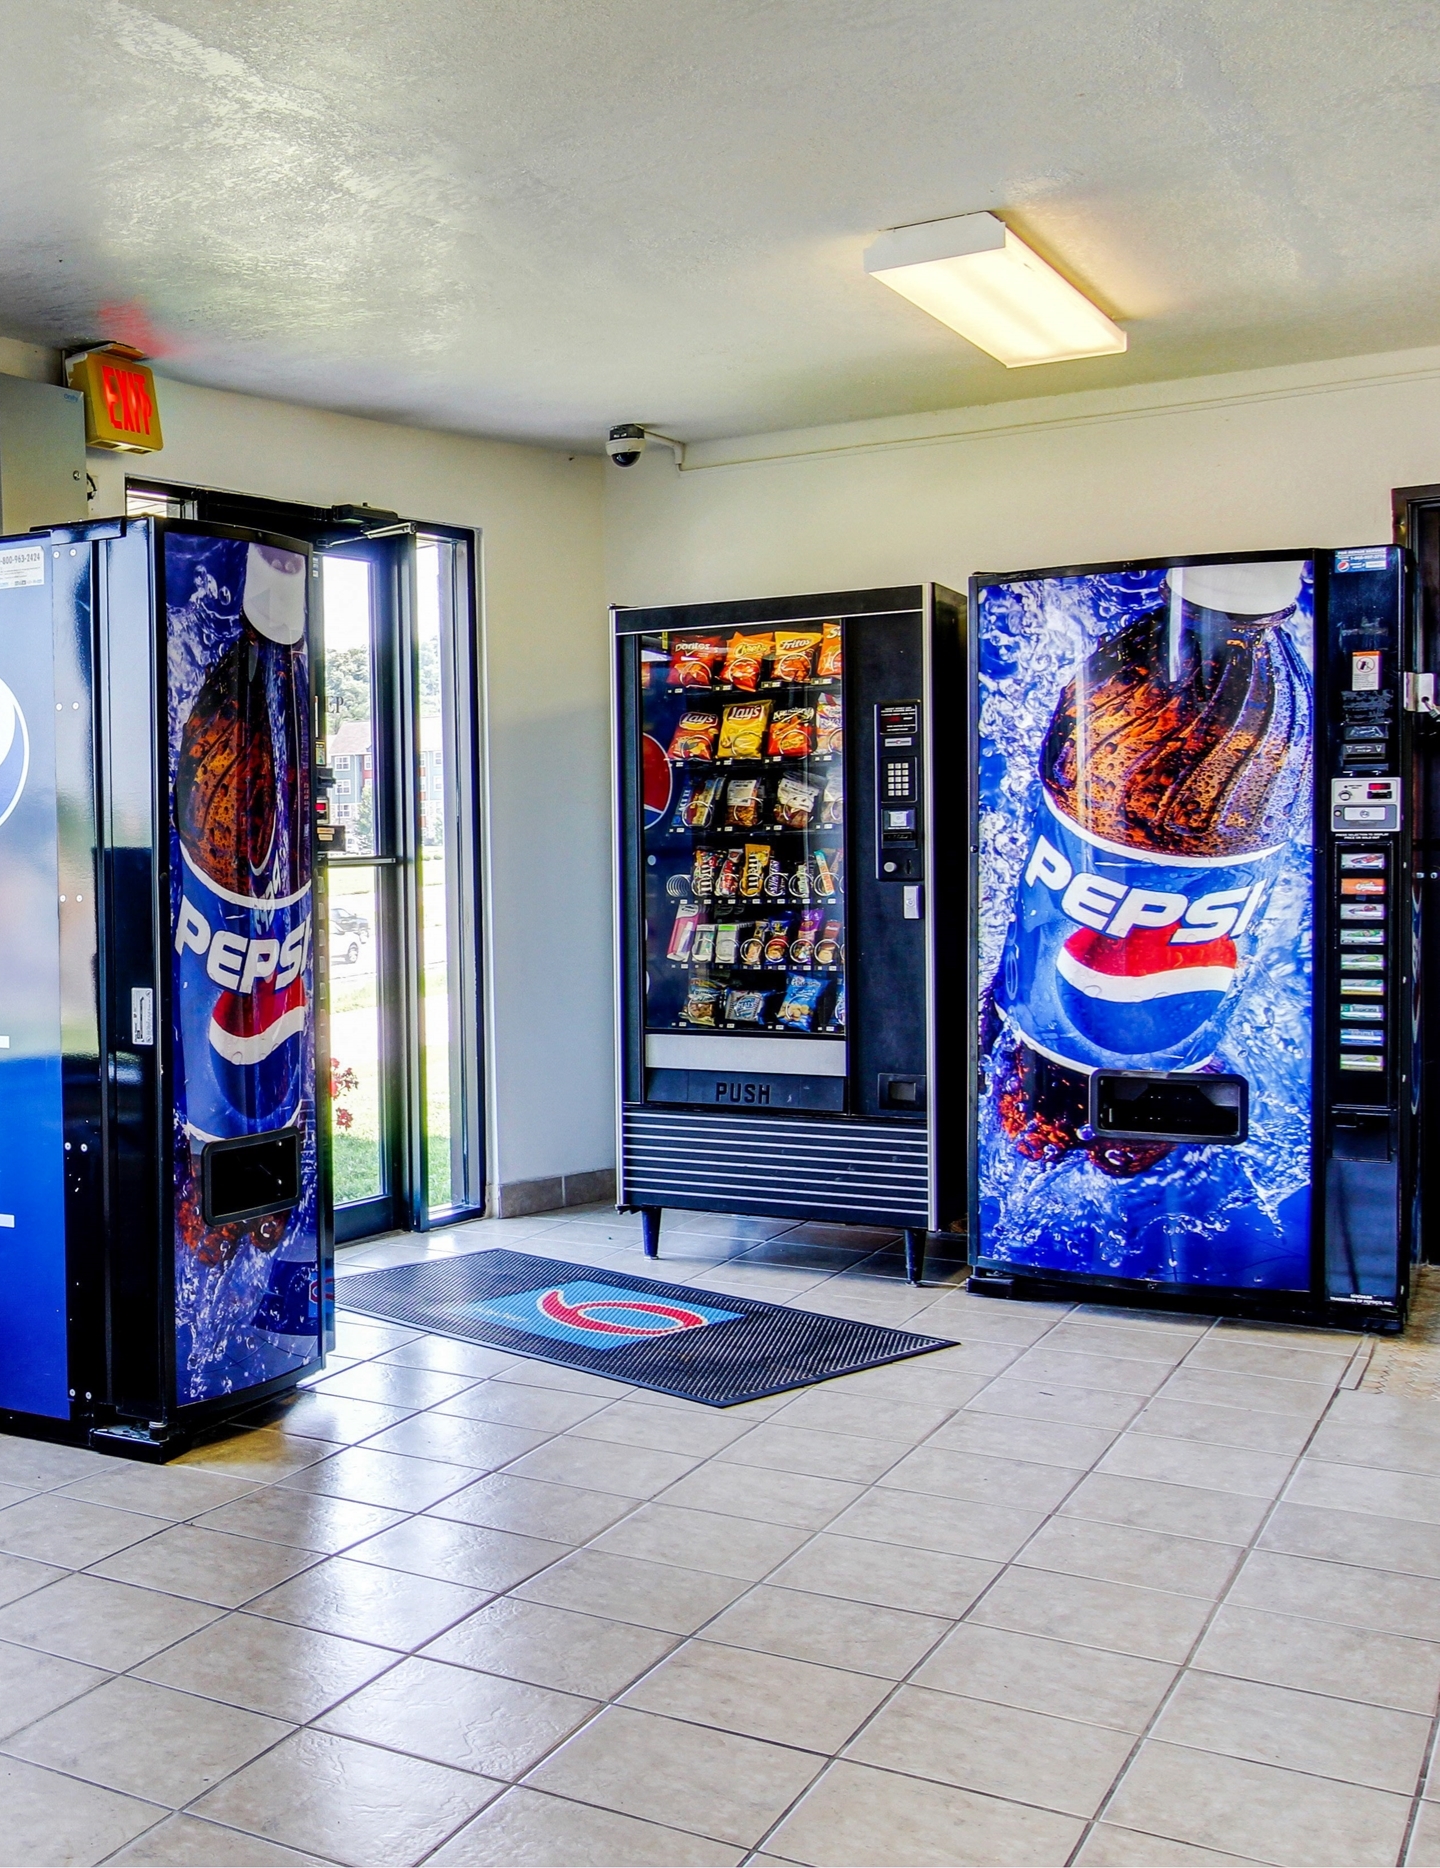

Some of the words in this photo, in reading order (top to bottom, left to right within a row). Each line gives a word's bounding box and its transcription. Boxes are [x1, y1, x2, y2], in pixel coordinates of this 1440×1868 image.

[101, 365, 153, 436] EXIT
[675, 641, 710, 652] Doritos
[779, 638, 811, 650] Fritos
[729, 705, 760, 720] Lay's
[1023, 835, 1266, 946] PEPSI
[174, 894, 312, 995] PEPSI
[715, 1081, 770, 1104] PUSH
